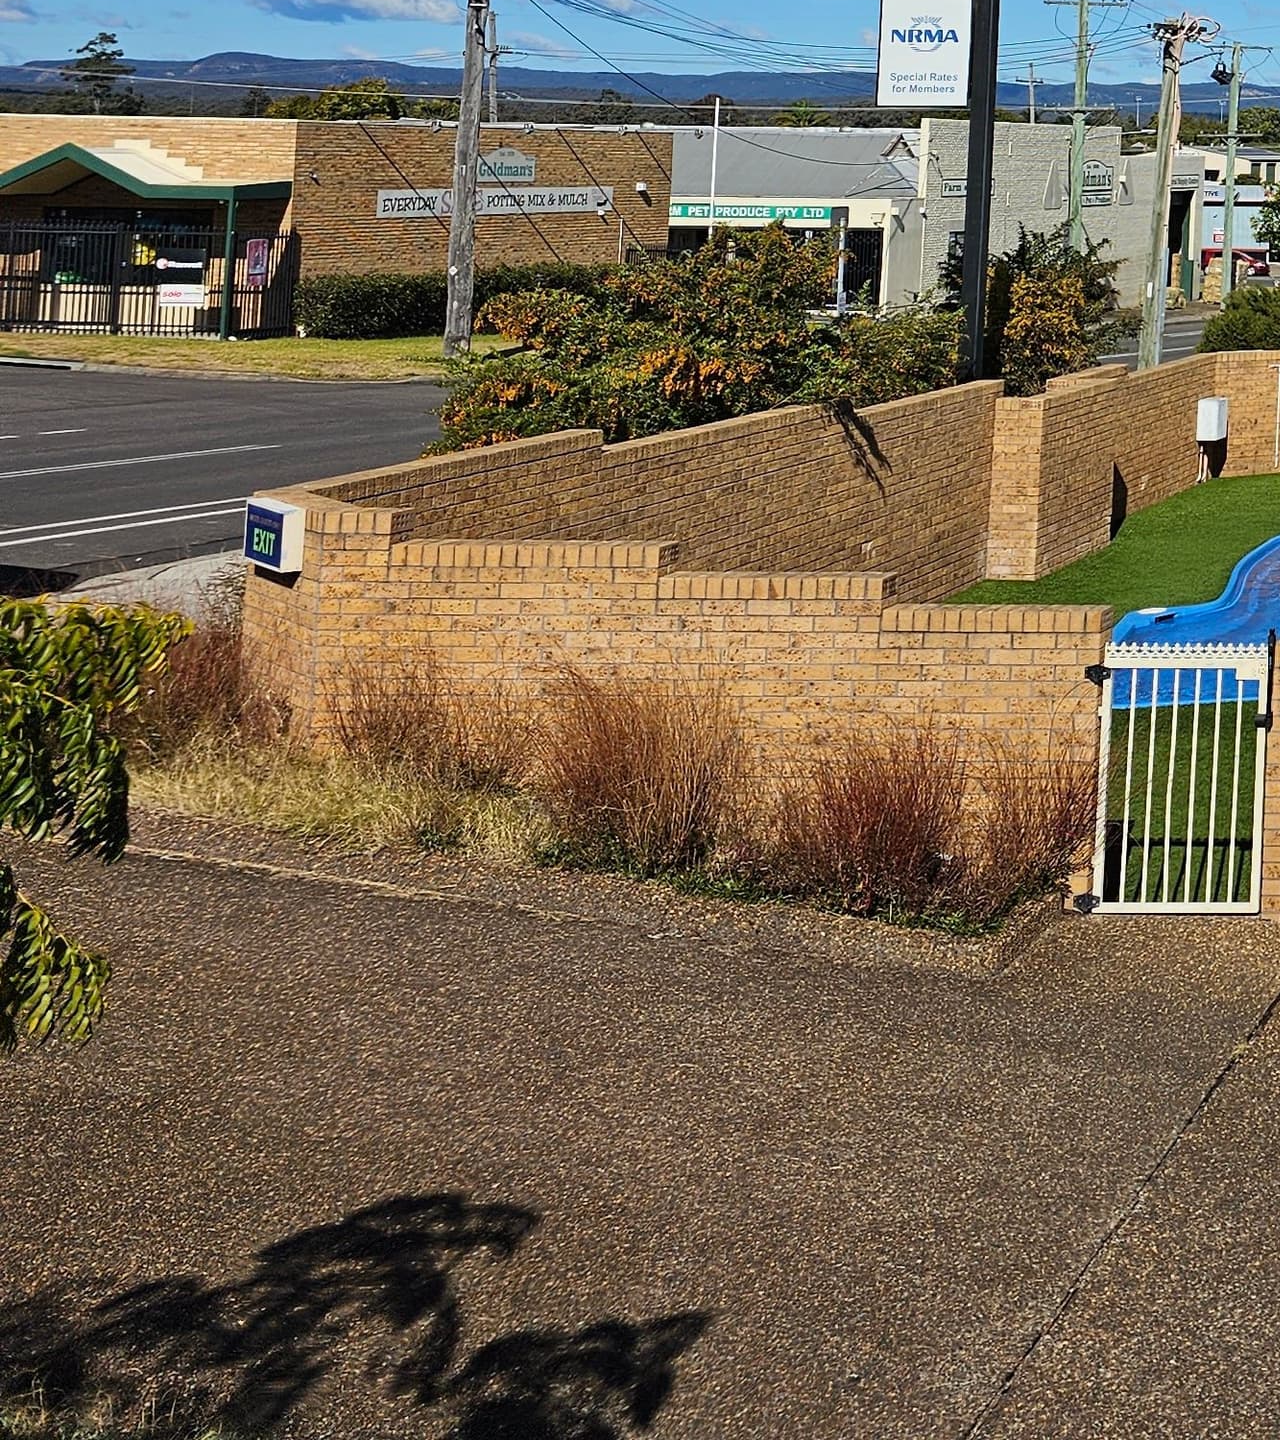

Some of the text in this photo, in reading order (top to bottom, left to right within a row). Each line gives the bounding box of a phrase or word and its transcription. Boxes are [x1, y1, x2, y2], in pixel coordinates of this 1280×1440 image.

[891, 29, 959, 43] NRMA
[890, 72, 958, 83] Special Rates
[892, 84, 956, 93] for Members
[479, 161, 533, 177] Goldman's
[382, 196, 438, 213] EVERYDAY
[487, 194, 525, 208] POTTING
[528, 194, 546, 207] MIX
[547, 193, 556, 206] &
[558, 193, 588, 206] MULCH
[688, 206, 710, 217] PET
[715, 206, 771, 217] PRODUCE
[775, 207, 798, 218] PTY
[803, 207, 825, 218] LTD
[253, 528, 276, 556] EXIT
